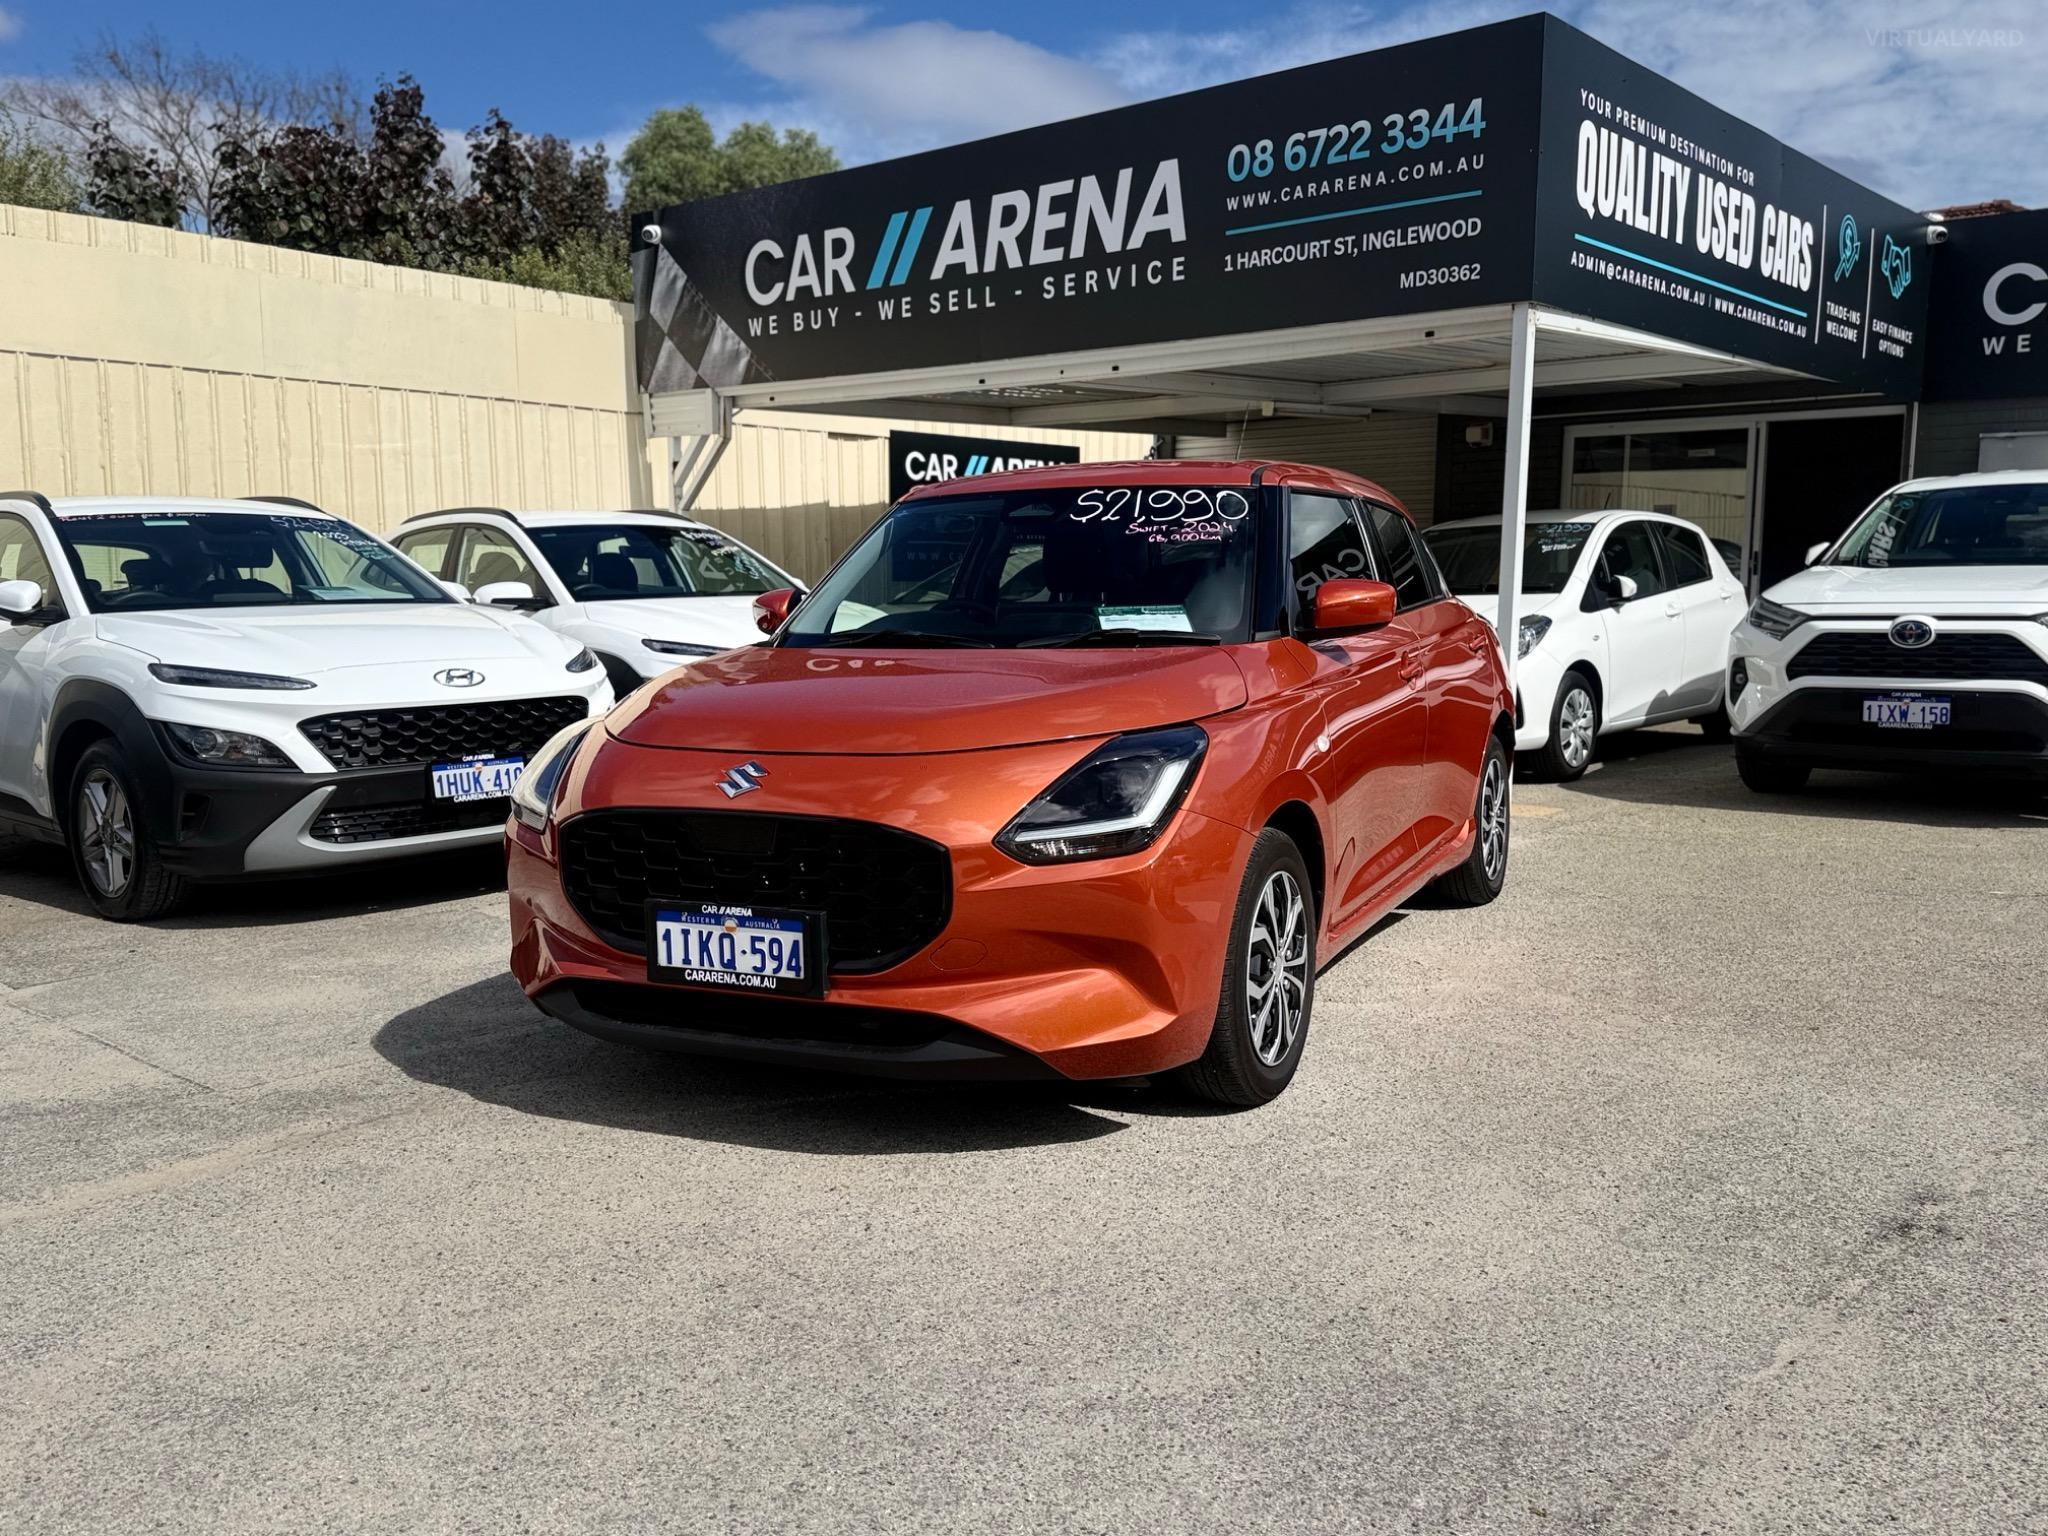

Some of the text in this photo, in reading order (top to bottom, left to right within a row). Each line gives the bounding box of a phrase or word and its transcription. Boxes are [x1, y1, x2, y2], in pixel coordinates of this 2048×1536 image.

[1227, 97, 1487, 183] 08 6722 3344
[1581, 88, 1755, 188] YOUR PREMIUM DESTINATION FOR
[1226, 153, 1486, 212] WWW.CARARENA.COM.AU
[1576, 119, 1815, 292] QUALITY USED CARS
[744, 157, 1188, 307] CAR ARENA
[1224, 217, 1482, 273] 1 HARCOURT ST, INGLEWOOD
[1400, 263, 1481, 289] MD30362
[748, 315, 779, 338] WE
[793, 307, 840, 333] BUY
[878, 297, 912, 320] WE
[928, 289, 997, 315] SELL
[1042, 256, 1187, 300] SERVICE
[1571, 250, 1808, 339] ADMIN@CARARENA.COM.AU WWW.CARARENA.COM.AU
[1826, 301, 1861, 326] TRADE-INS
[1826, 320, 1858, 343] WELCOME
[1872, 318, 1913, 344] EASY FINANCE
[1982, 334, 2032, 356] WE
[1879, 339, 1905, 359] OPTIONS
[904, 451, 958, 482] CAR
[681, 915, 716, 925] WESTERN
[701, 904, 718, 914] CAR
[685, 969, 777, 989] CARARENA.COM.AU
